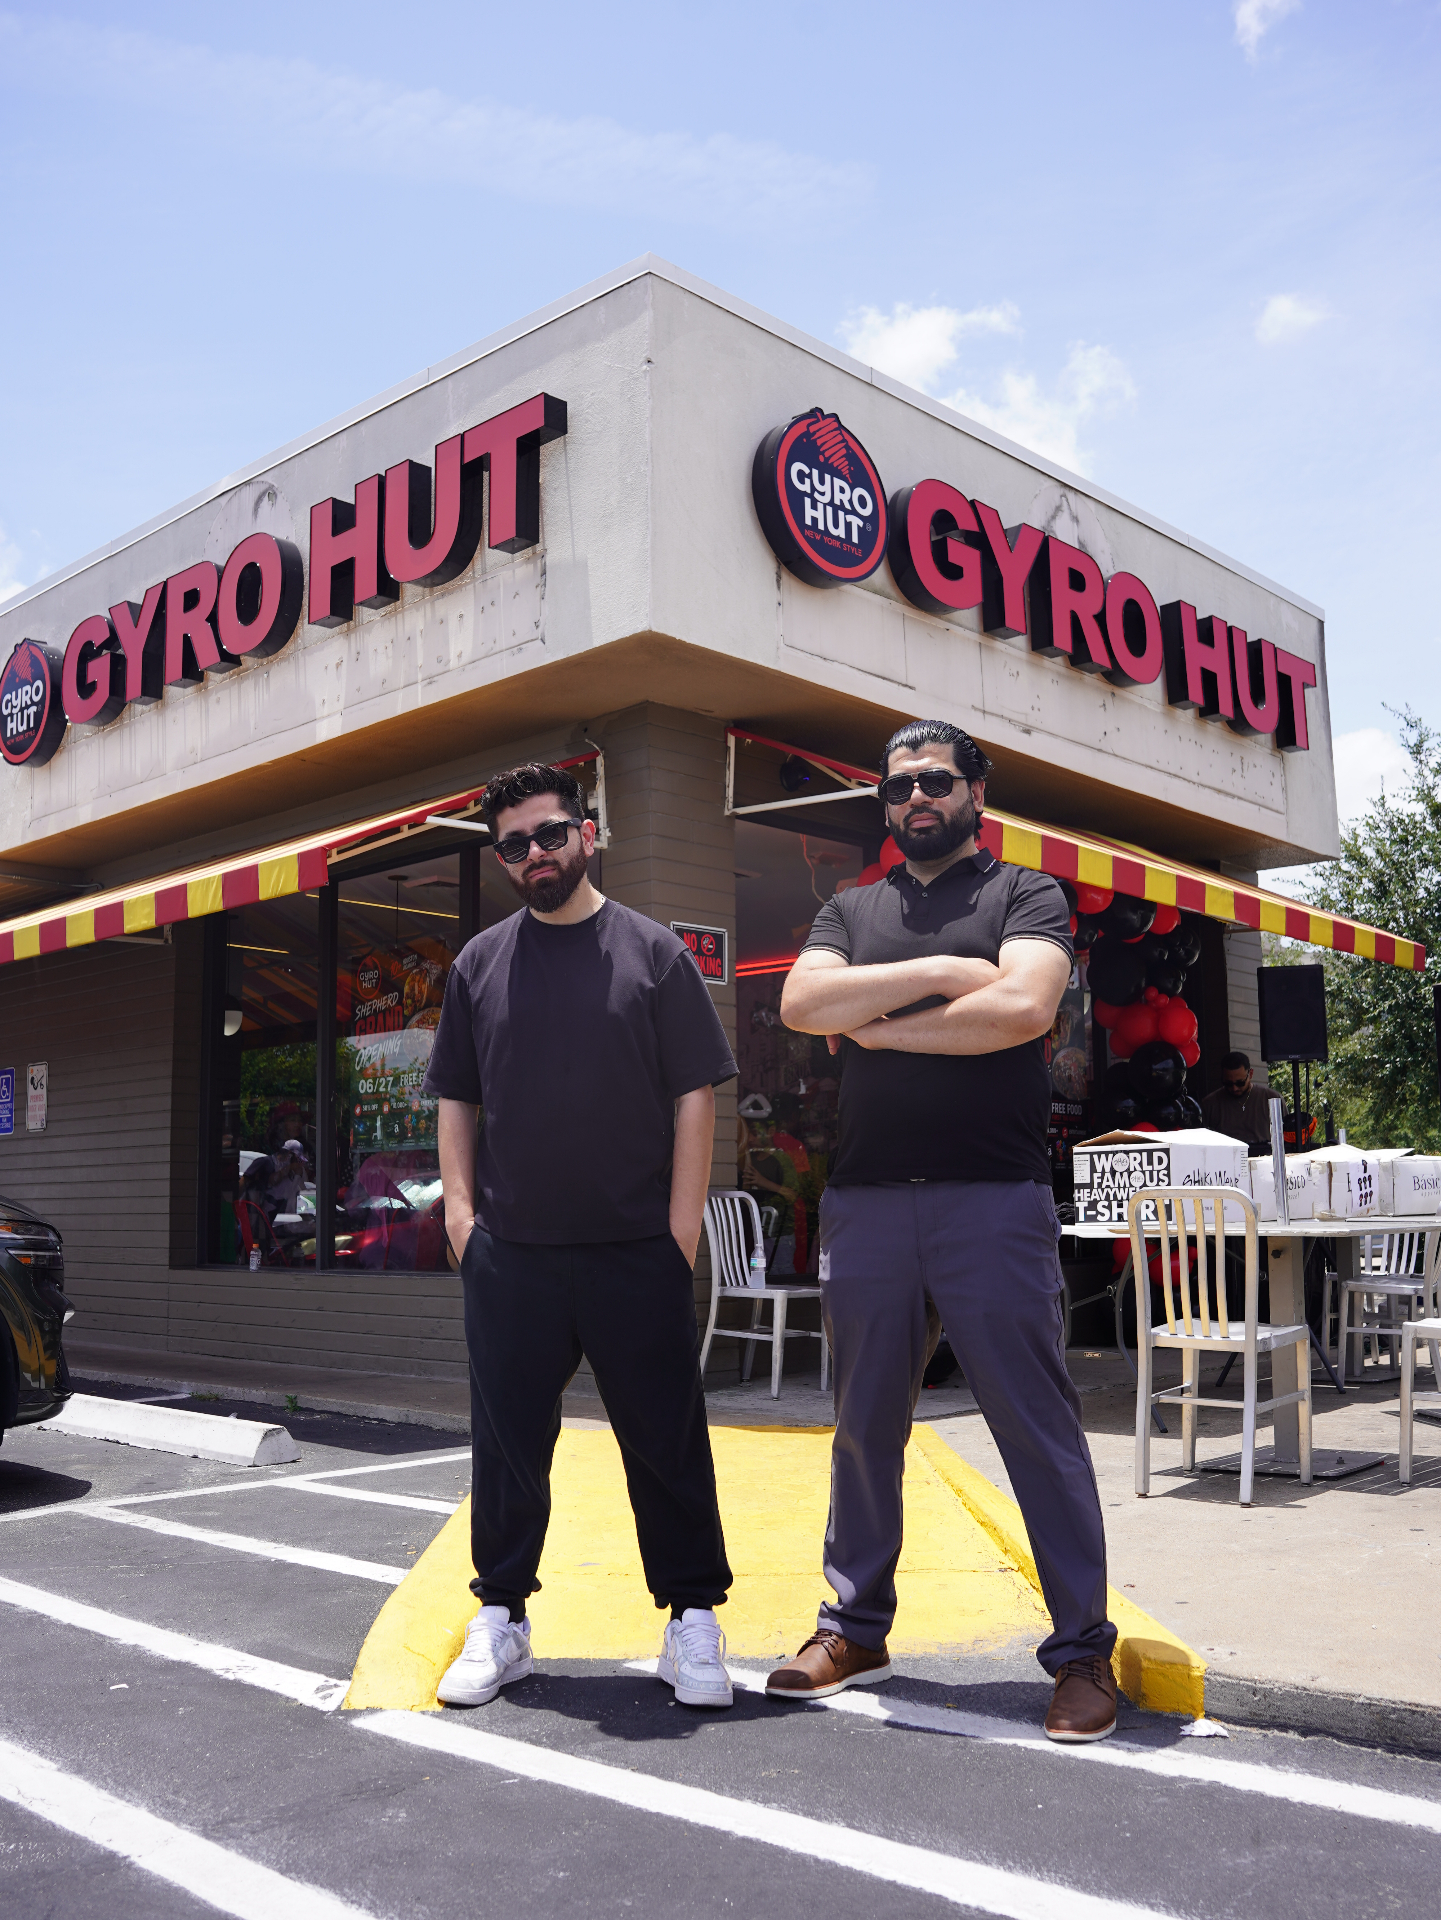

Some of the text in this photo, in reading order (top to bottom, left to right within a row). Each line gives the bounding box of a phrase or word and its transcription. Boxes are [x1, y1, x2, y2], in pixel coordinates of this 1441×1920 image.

[790, 461, 873, 517] GYRO
[804, 496, 864, 545] HUT
[804, 529, 863, 557] NEW YORK STYLE
[62, 392, 547, 725] GYRO HUT
[907, 478, 1317, 751] GYRO HUT
[2, 680, 43, 715] GYRO
[7, 706, 37, 737] HUT
[683, 931, 698, 952] NO
[359, 970, 379, 981] GYRO
[694, 954, 722, 977] KING
[362, 979, 376, 989] HUT
[354, 992, 399, 1021] SHEPHERD
[355, 1005, 403, 1050] GRAND
[355, 1034, 402, 1071] OPENING
[358, 1076, 394, 1094] 06/27
[400, 1072, 418, 1086] FREE
[1051, 1102, 1083, 1115] FREE FOOD
[1093, 1151, 1169, 1173] WORLD
[1093, 1169, 1169, 1189] FAMOUS
[1074, 1187, 1141, 1202] HEAVYWE
[1075, 1199, 1170, 1222] T-SHR
